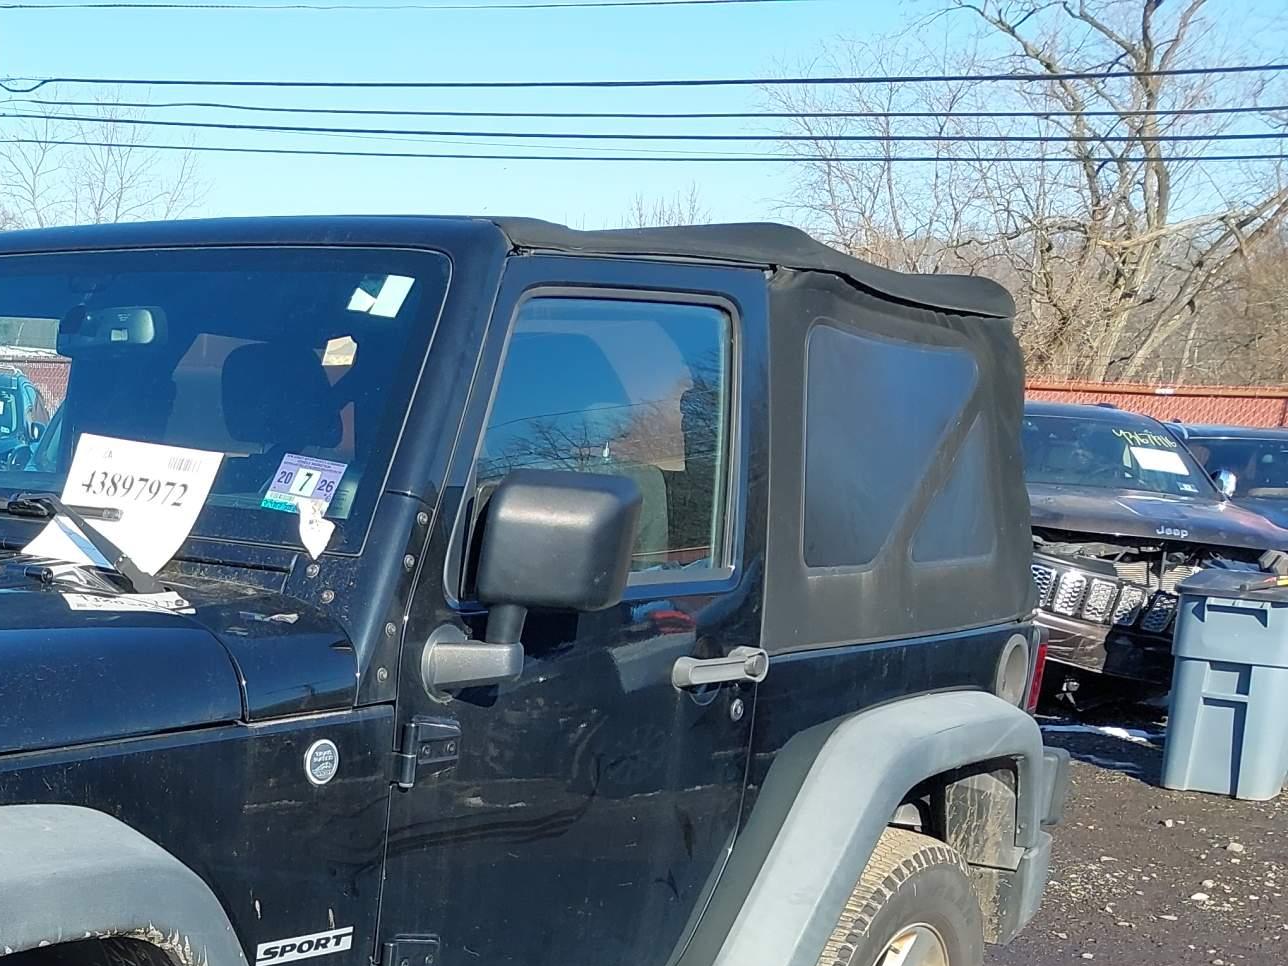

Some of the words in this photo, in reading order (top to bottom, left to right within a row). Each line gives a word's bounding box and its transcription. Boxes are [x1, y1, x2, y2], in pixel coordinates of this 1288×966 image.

[82, 470, 189, 507] 43897972
[277, 470, 294, 485] 20
[299, 471, 314, 492] 7
[316, 479, 335, 493] 26
[1156, 526, 1189, 539] Jeep
[258, 932, 351, 961] SPORT
